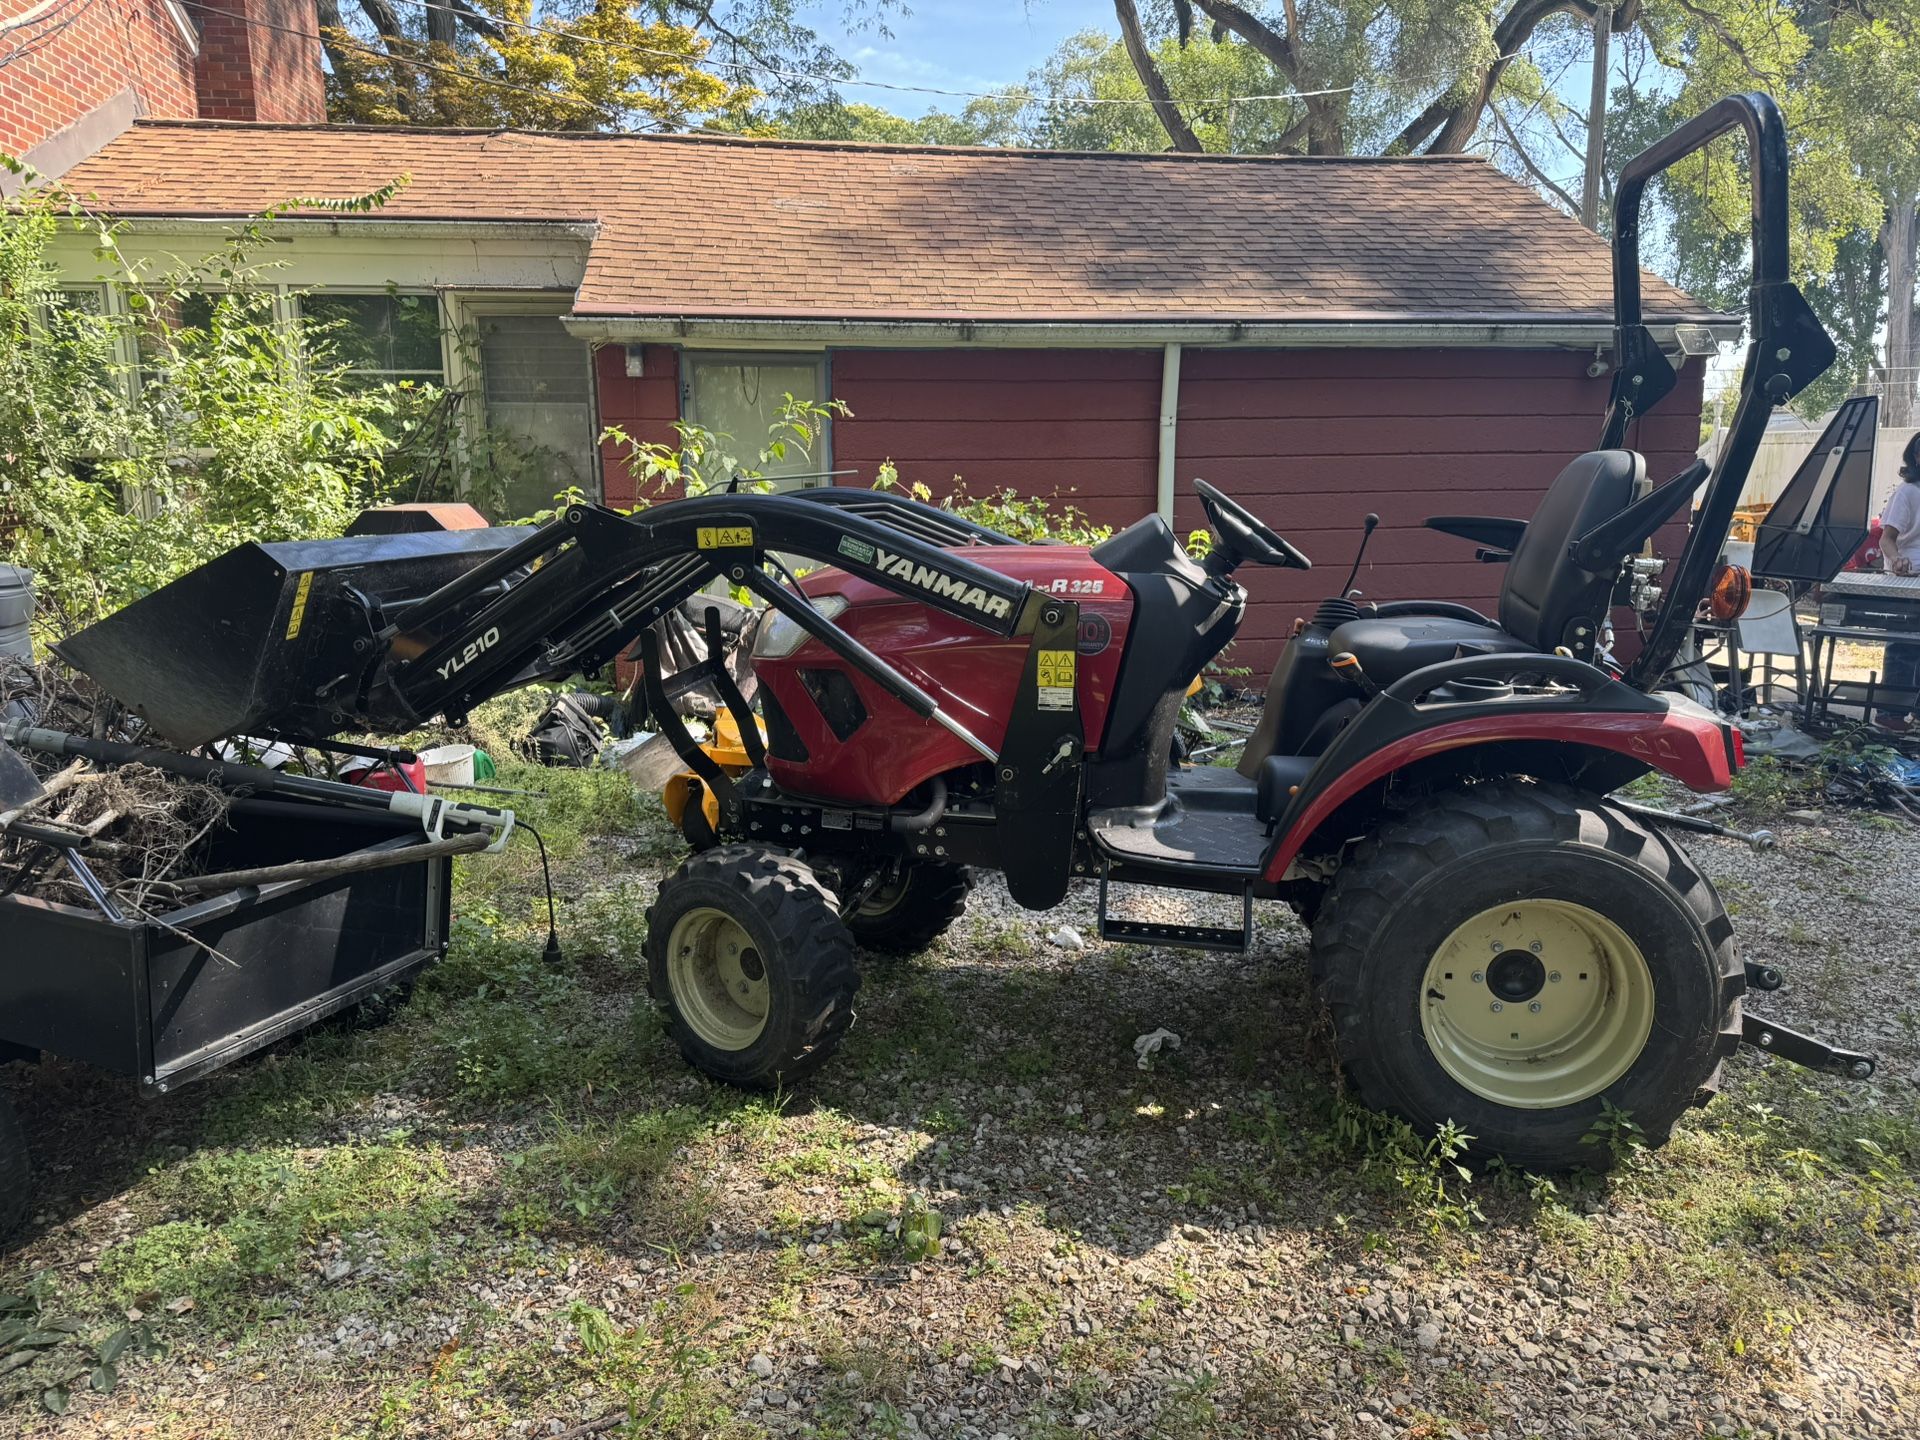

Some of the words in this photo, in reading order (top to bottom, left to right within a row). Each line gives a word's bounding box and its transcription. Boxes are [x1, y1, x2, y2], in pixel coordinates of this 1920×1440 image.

[875, 548, 1011, 619] YANMAR
[1051, 579, 1068, 592] R
[1070, 580, 1104, 593] 325
[436, 626, 500, 680] YL210
